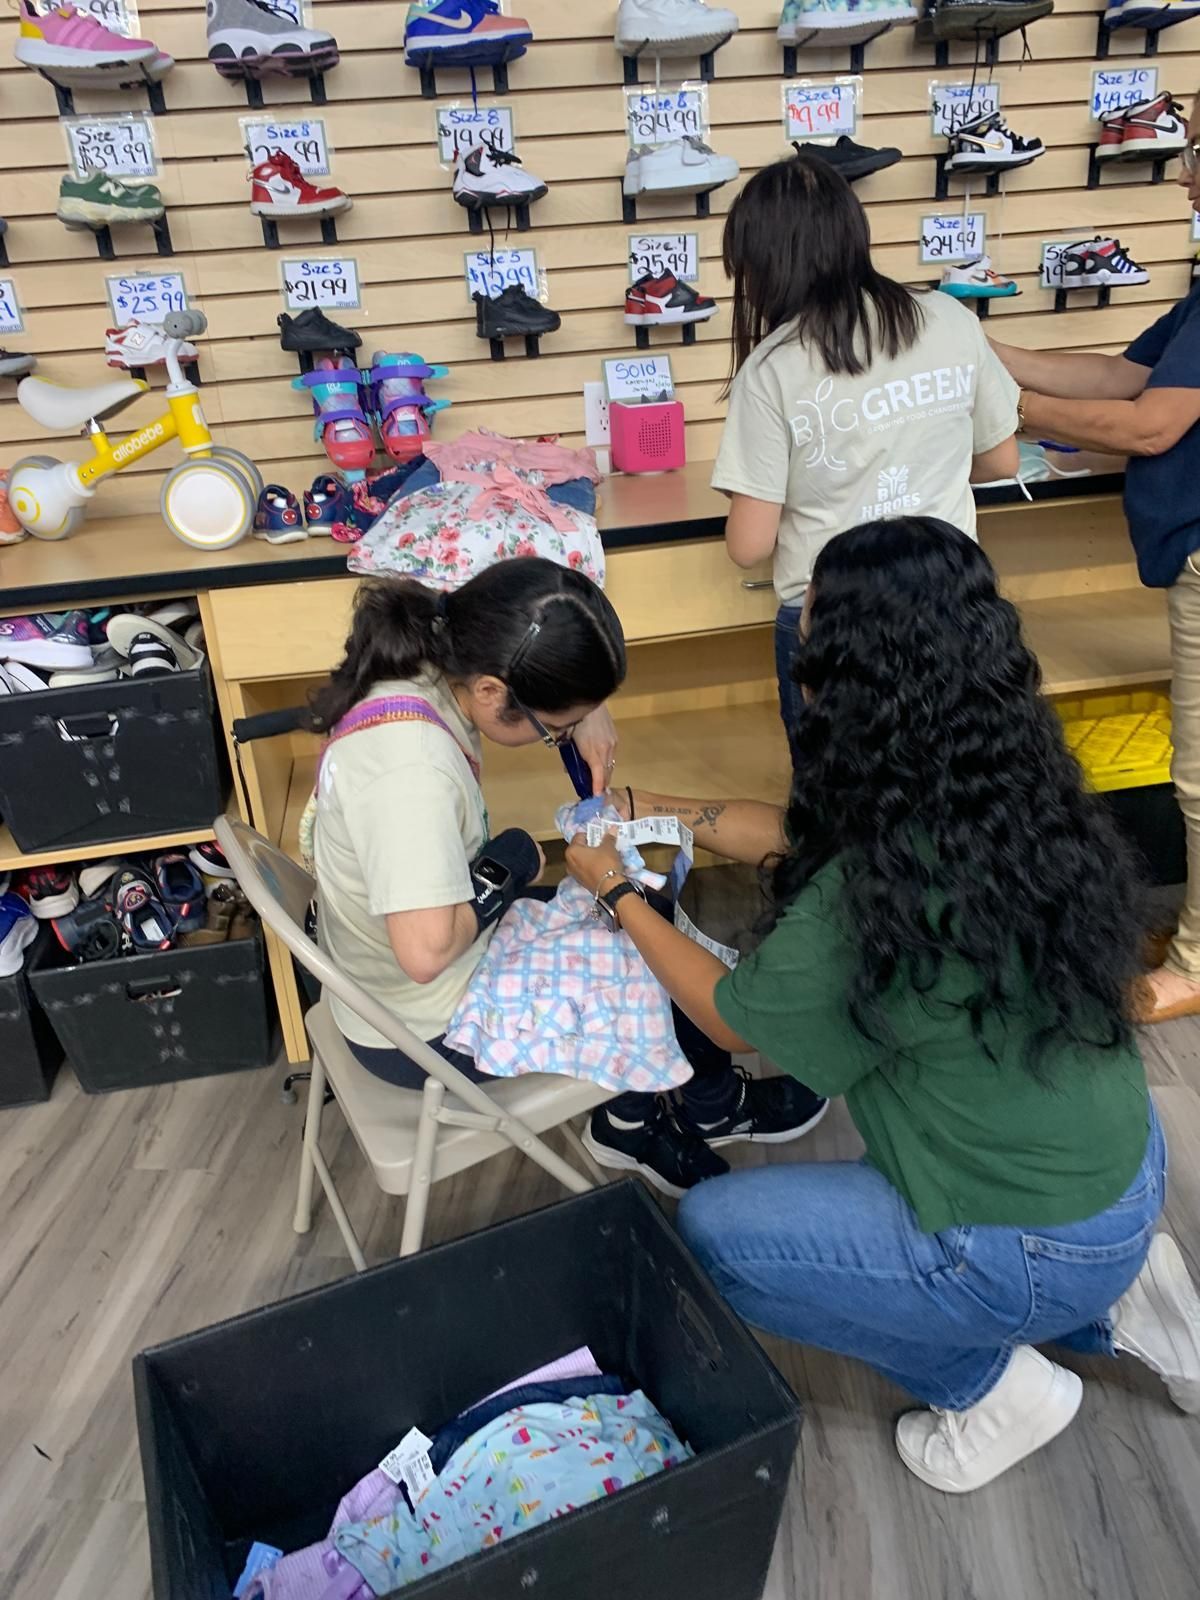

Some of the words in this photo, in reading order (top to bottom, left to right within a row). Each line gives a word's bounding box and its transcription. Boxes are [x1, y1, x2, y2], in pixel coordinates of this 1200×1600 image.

[1098, 72, 1123, 85] Size
[1128, 69, 1149, 85] 10
[797, 89, 831, 103] Size
[832, 86, 841, 101] 9
[449, 110, 484, 124] Size
[488, 109, 499, 125] 8
[627, 109, 698, 137] $24.99
[76, 127, 115, 145] Size
[119, 125, 134, 141] 7
[267, 126, 299, 139] Size
[78, 142, 149, 172] $39.99
[934, 217, 960, 229] Size
[638, 238, 674, 251] Size
[510, 251, 521, 263] 5
[301, 262, 330, 276] Size
[333, 262, 343, 275] 5
[119, 279, 158, 294] Size
[160, 276, 177, 289] 5
[284, 278, 347, 301] $21.99
[615, 360, 657, 380] Sold
[861, 364, 975, 421] GREEN
[113, 423, 164, 462] allobebe
[861, 492, 921, 520] HEROES
